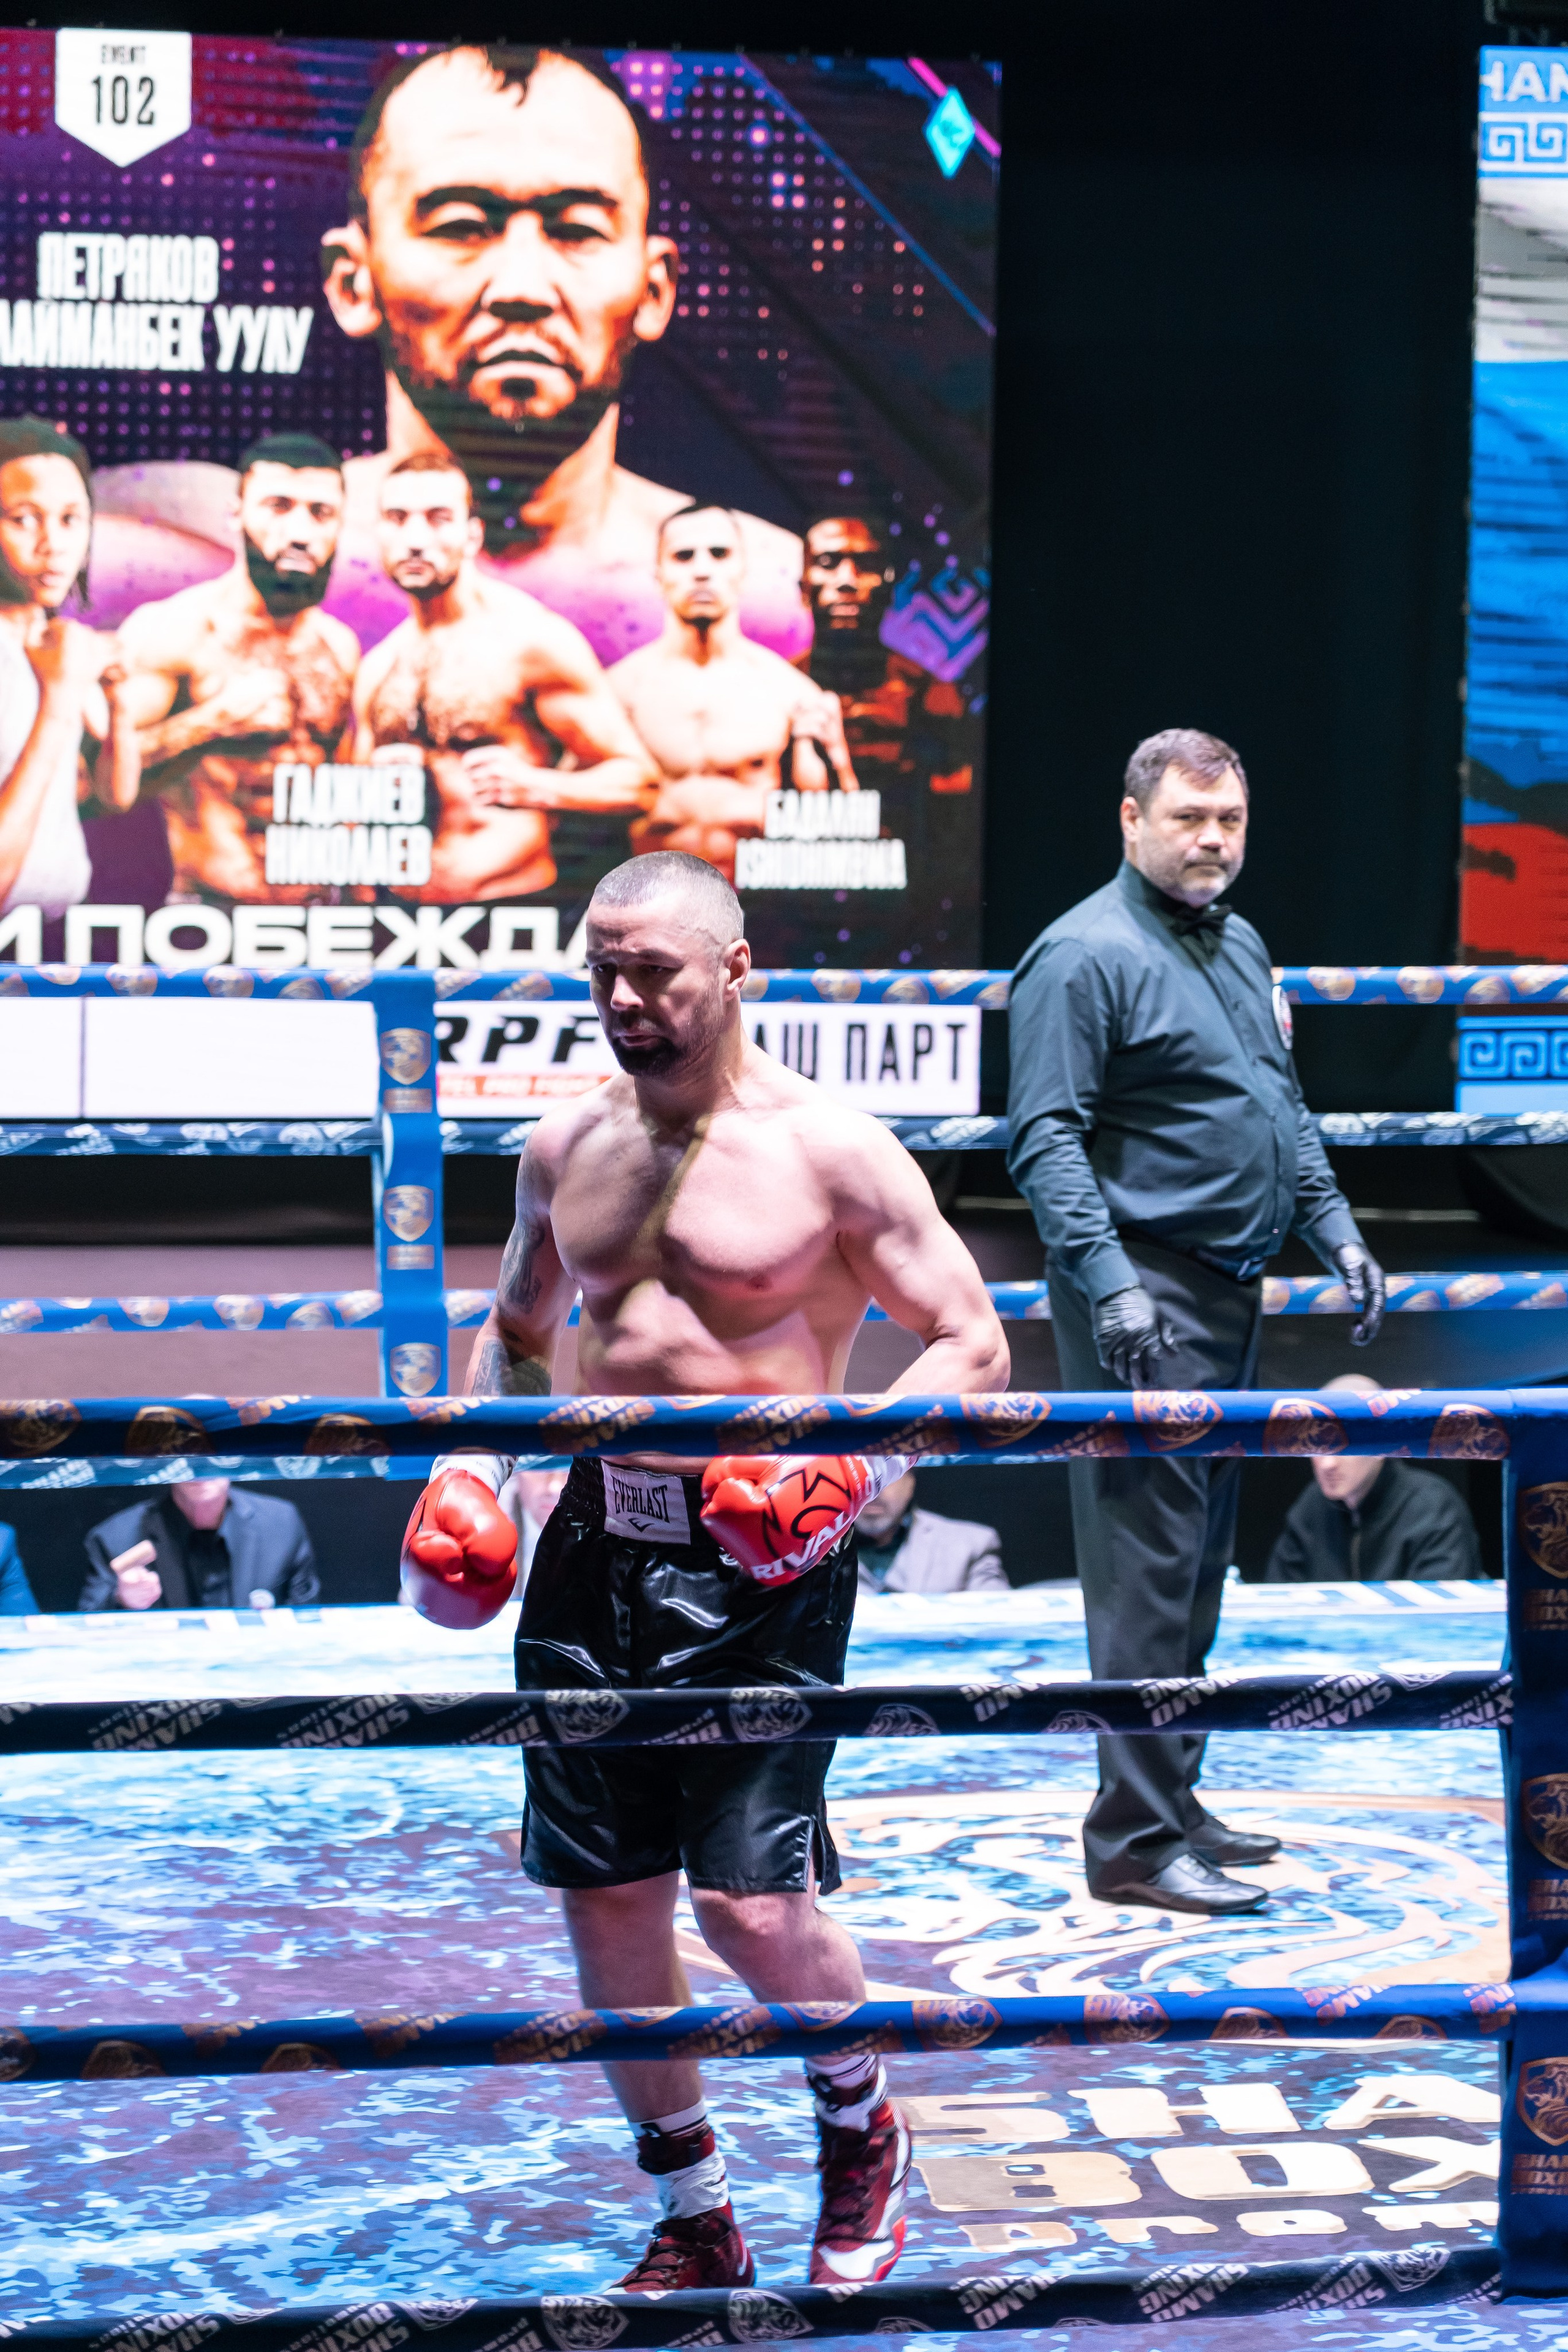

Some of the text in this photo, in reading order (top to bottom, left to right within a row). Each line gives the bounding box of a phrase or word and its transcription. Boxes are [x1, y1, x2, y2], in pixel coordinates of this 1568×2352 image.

[92, 75, 155, 125] 102
[37, 232, 220, 303] ПЕТРЯКОВ
[213, 304, 314, 374] УУЛУ
[752, 1022, 968, 1083] АШ ПАРТ
[610, 1475, 670, 1524] EVERLAST
[753, 1511, 853, 1581] RIVAL
